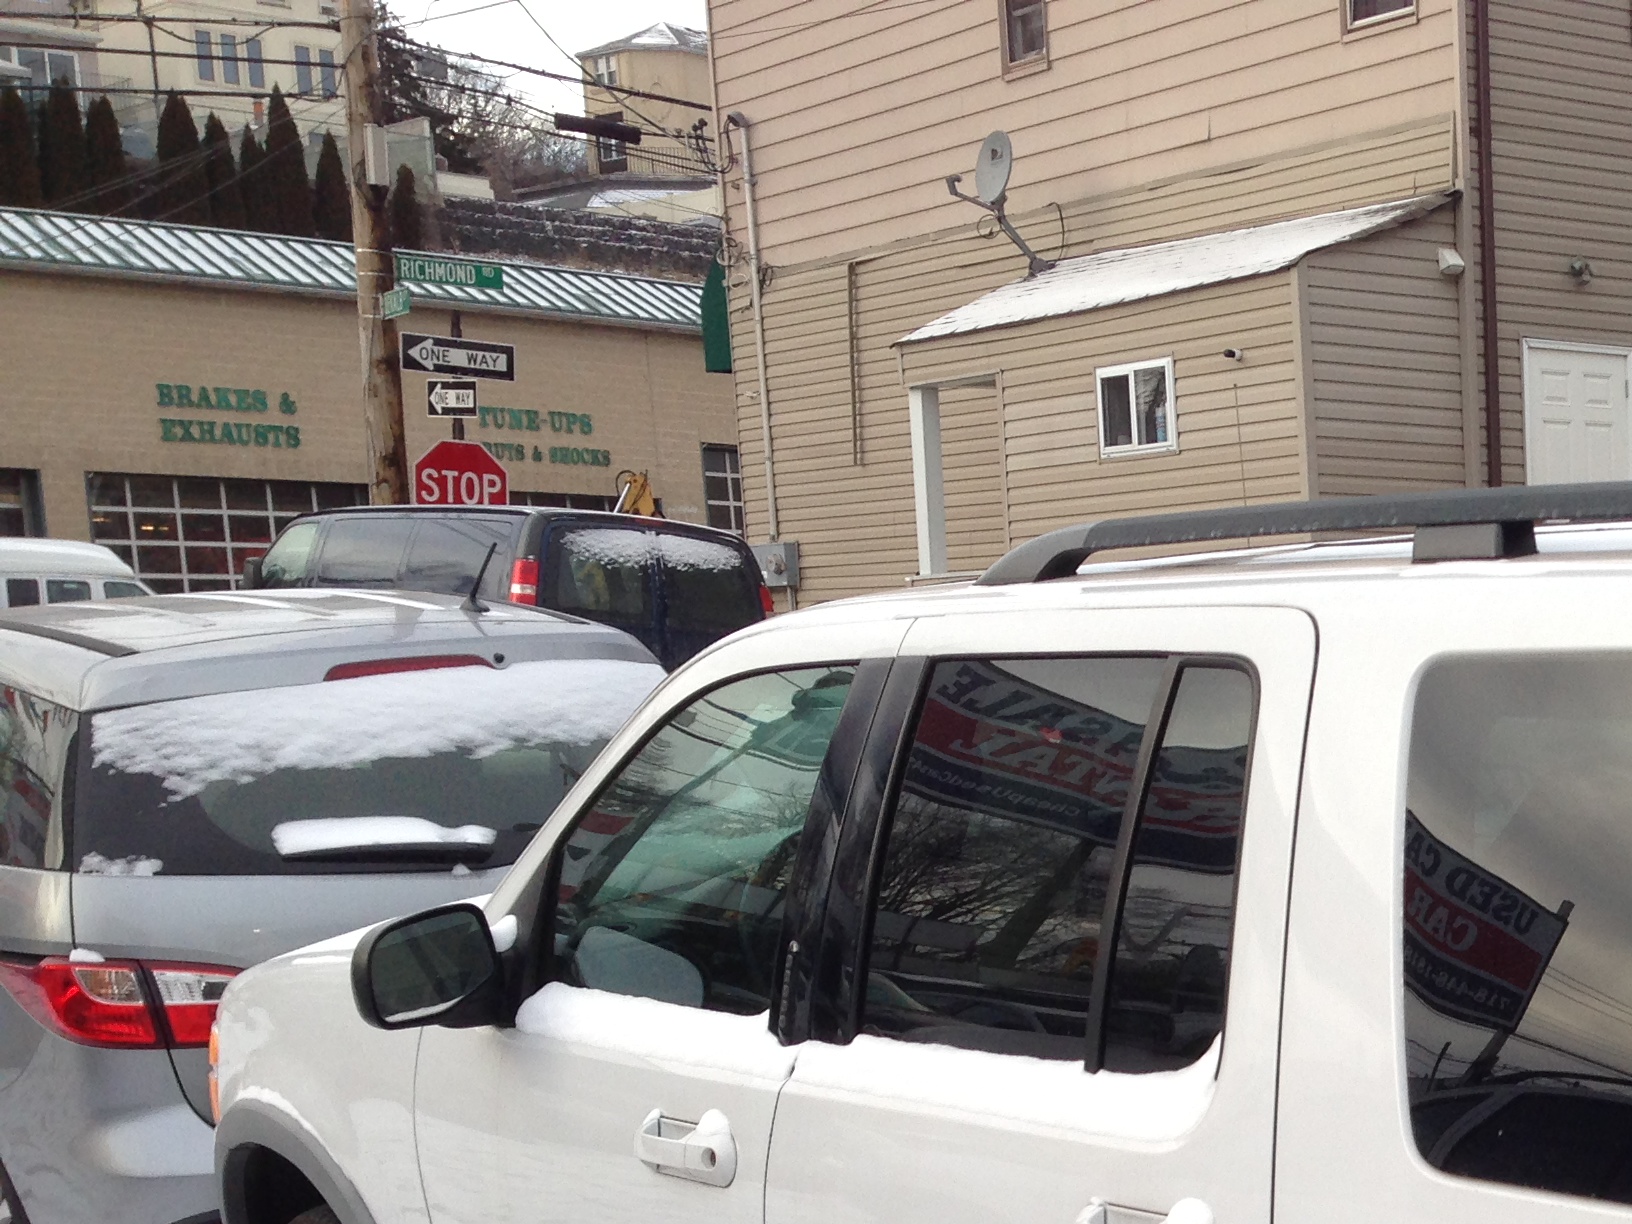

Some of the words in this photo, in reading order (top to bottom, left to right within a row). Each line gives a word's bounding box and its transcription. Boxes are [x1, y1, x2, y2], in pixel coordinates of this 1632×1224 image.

[400, 259, 476, 284] RICHMOND
[482, 266, 495, 278] RD
[420, 346, 451, 363] ONE
[466, 352, 500, 368] WAY
[155, 383, 268, 412] BRAKES
[279, 391, 297, 415] &
[434, 391, 449, 405] ONE
[454, 391, 471, 405] WAY
[158, 417, 300, 448] EXHAUSTS
[479, 406, 593, 435] TUNE-UPS
[531, 445, 542, 462] &
[549, 446, 611, 467] SHOCKS
[421, 468, 502, 505] STOP
